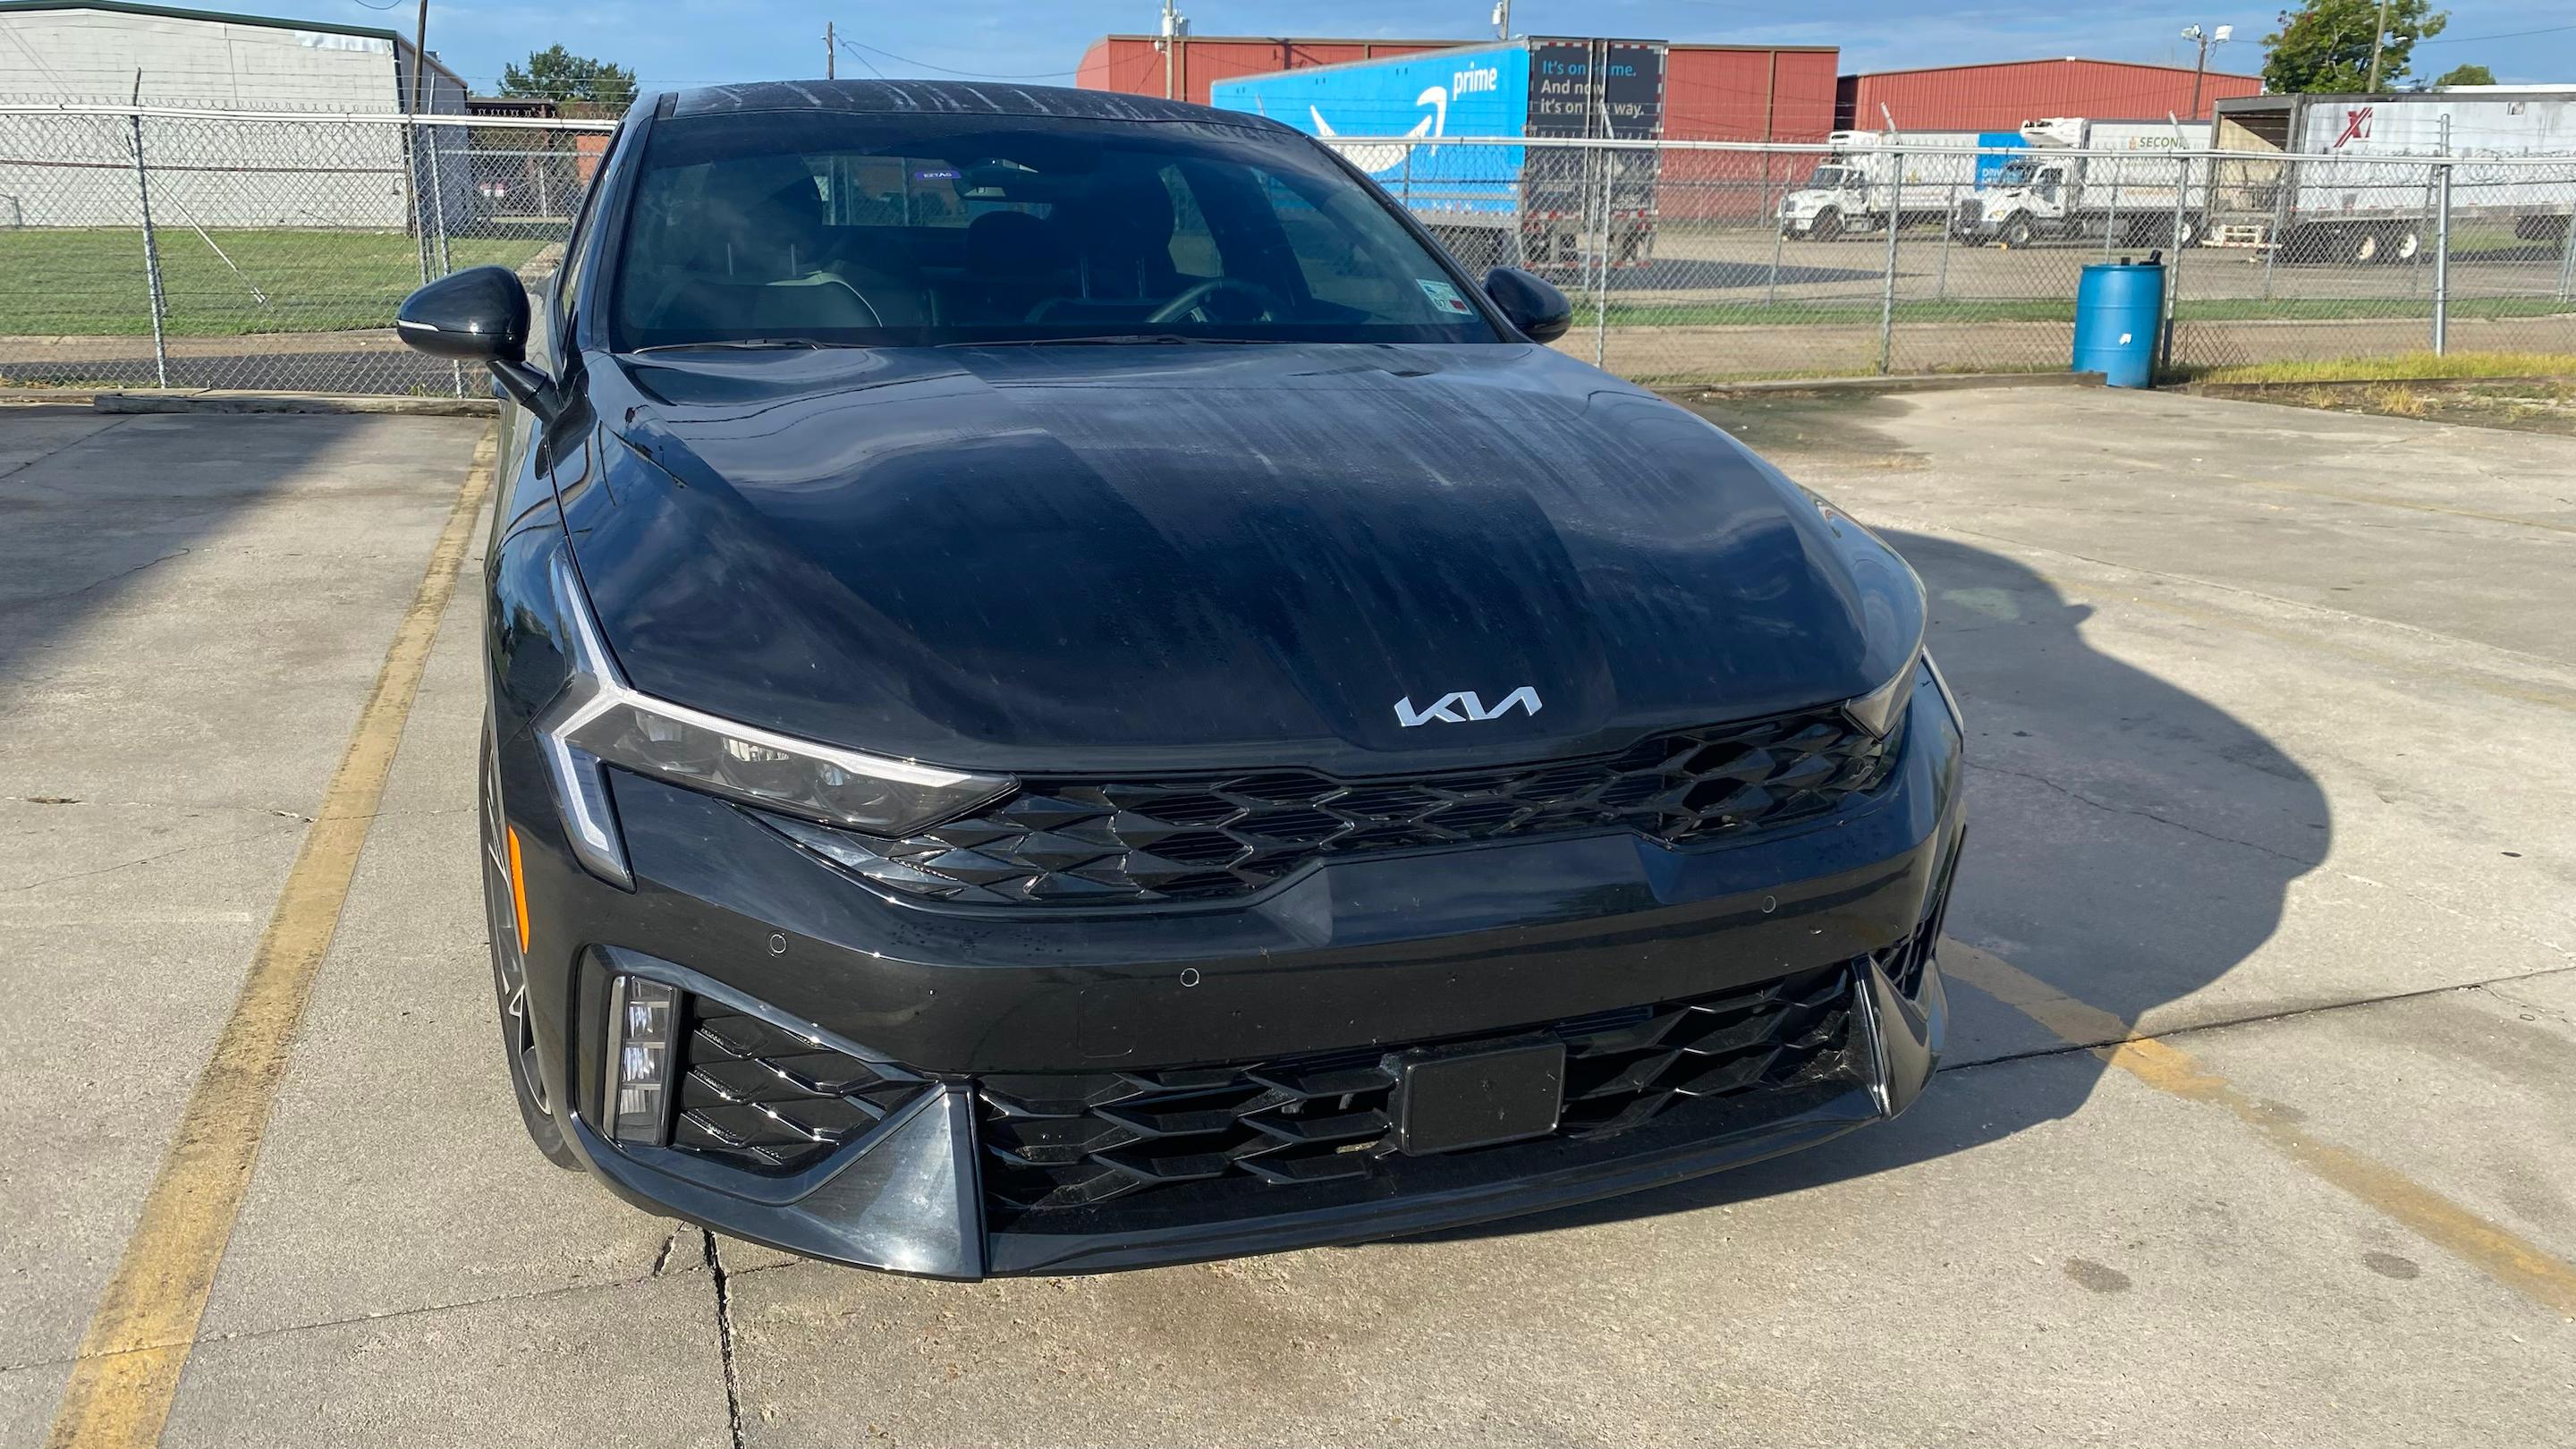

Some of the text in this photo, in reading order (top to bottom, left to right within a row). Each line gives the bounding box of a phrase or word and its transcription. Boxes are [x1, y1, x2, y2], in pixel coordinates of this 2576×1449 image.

[1542, 60, 1564, 74] It's
[1568, 64, 1587, 75] on
[1453, 61, 1498, 101] prime
[1540, 79, 1571, 94] And
[1540, 97, 1562, 114] it's
[1565, 102, 1583, 114] on
[1614, 102, 1645, 119] way.
[1394, 686, 1543, 727] KIA
